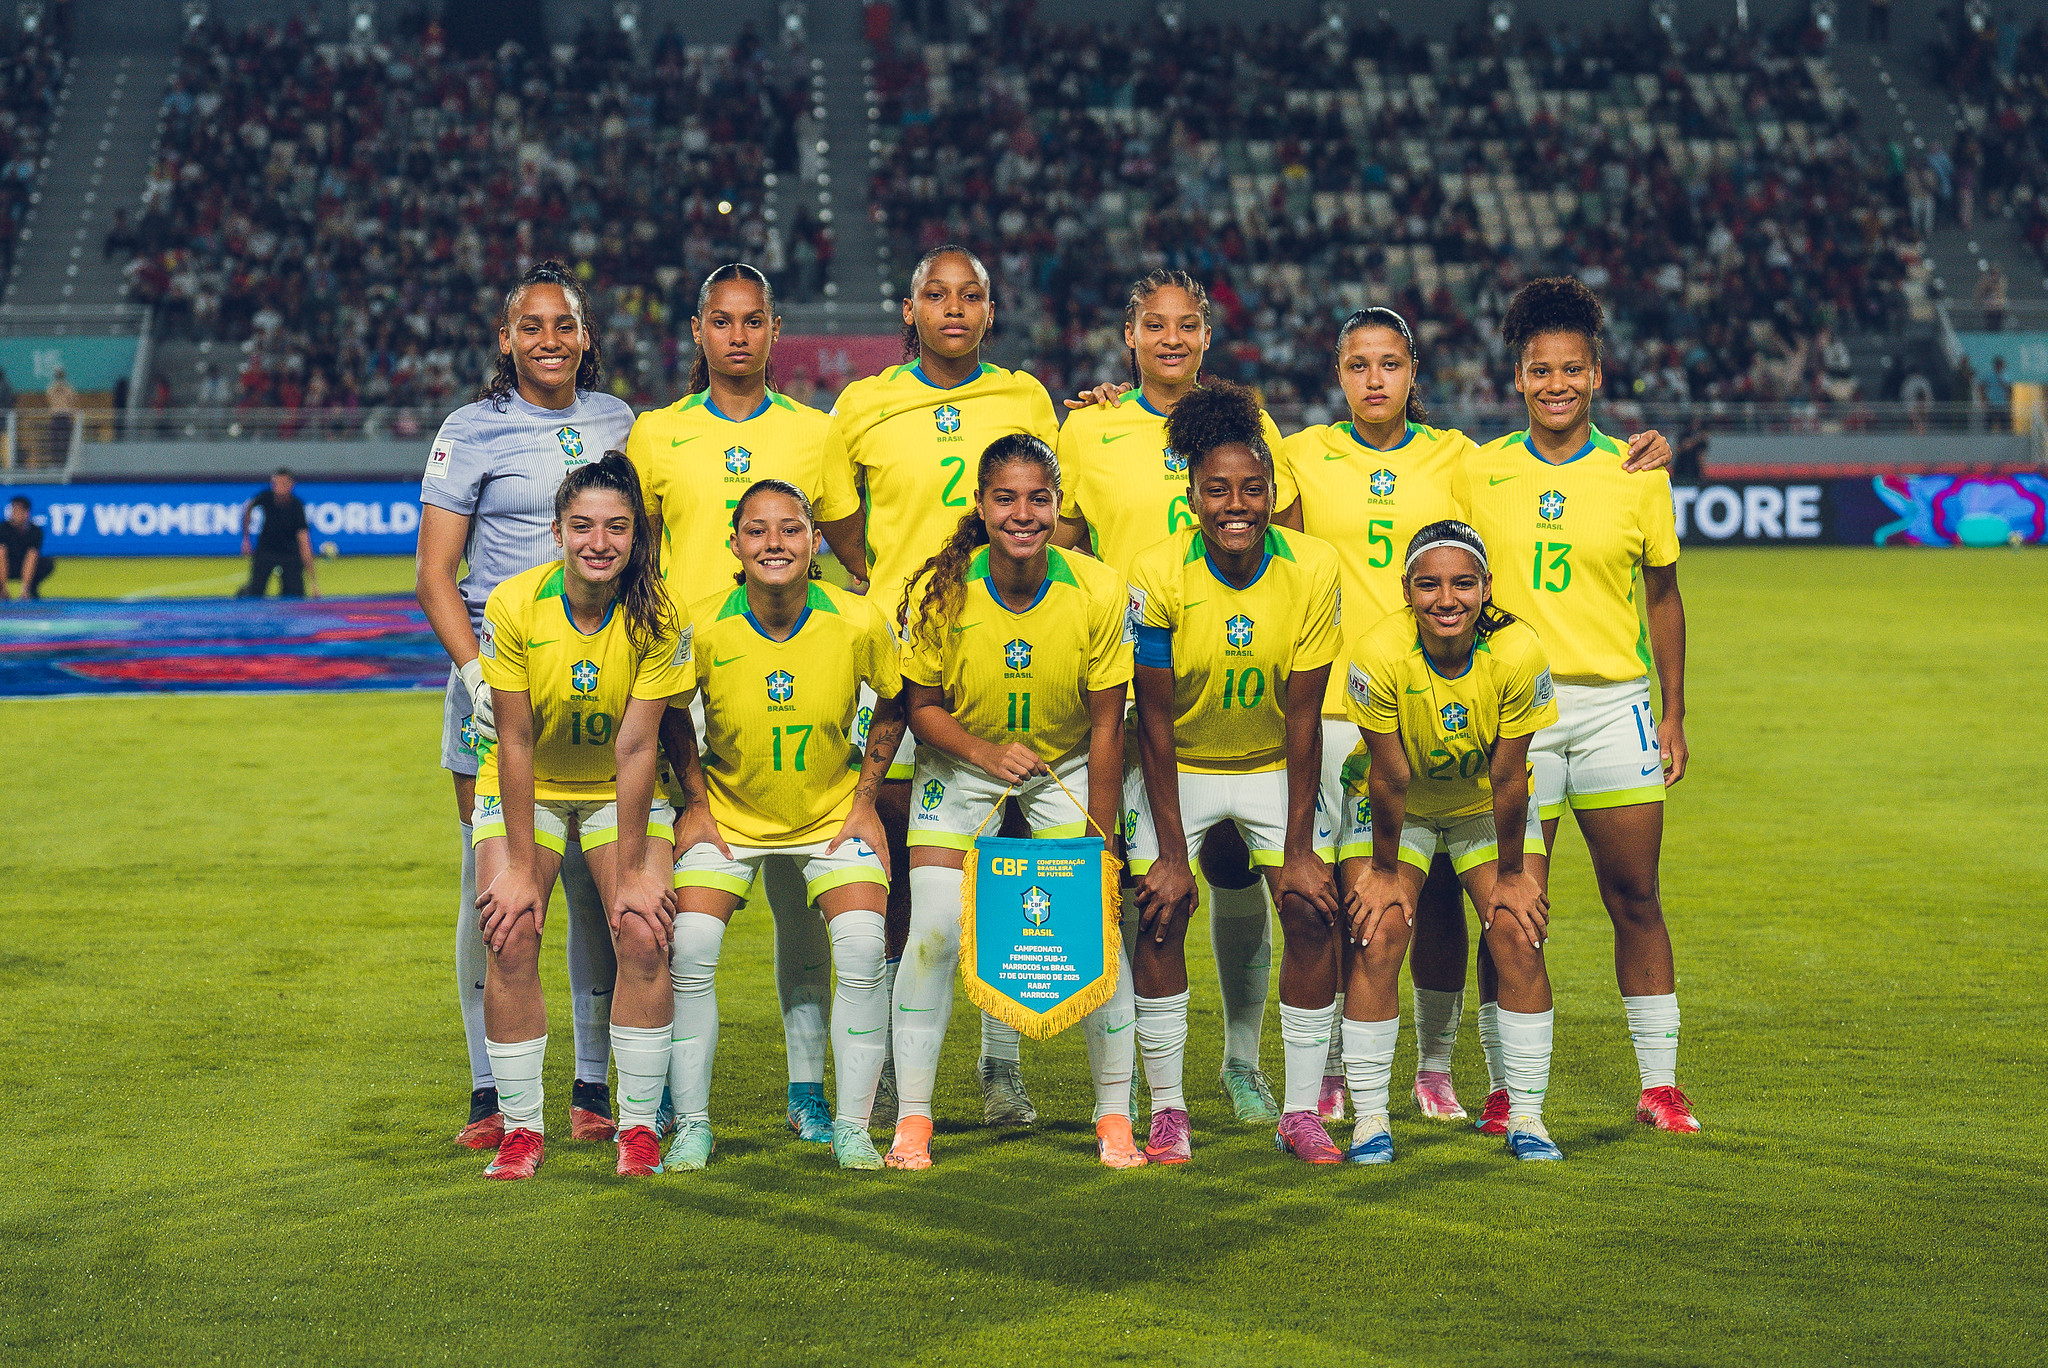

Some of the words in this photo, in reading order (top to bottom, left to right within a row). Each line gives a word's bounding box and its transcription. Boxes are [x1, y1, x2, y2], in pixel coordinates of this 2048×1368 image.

[940, 456, 967, 507] 2
[304, 501, 419, 535] ORLD
[1536, 522, 1564, 530] BRASIL
[1368, 519, 1393, 569] 5
[1533, 541, 1572, 593] 13
[1223, 667, 1265, 709] 10
[570, 694, 600, 702] BRASIL
[767, 704, 796, 712] BRASIL
[1007, 692, 1030, 732] 11
[571, 711, 612, 746] 19
[1443, 732, 1471, 743] BRASIL
[772, 724, 813, 772] 17
[1428, 749, 1485, 781] 20
[917, 813, 939, 822] BRASIL
[1353, 826, 1372, 834] BRAS
[991, 857, 1029, 877] CBF
[1022, 928, 1055, 937] BRASIL
[1013, 945, 1063, 953] CAMPEONATO
[1009, 954, 1043, 962] FEMININO
[1043, 955, 1068, 963] SUB-17
[1002, 963, 1041, 971] MARROCOS
[1050, 964, 1076, 972] BRASIL
[1007, 972, 1017, 980] DE
[1017, 972, 1052, 980] OUTUBRO
[1052, 973, 1063, 981] DE
[1027, 982, 1052, 990] RABAT
[1020, 991, 1060, 999] MARROCOS
